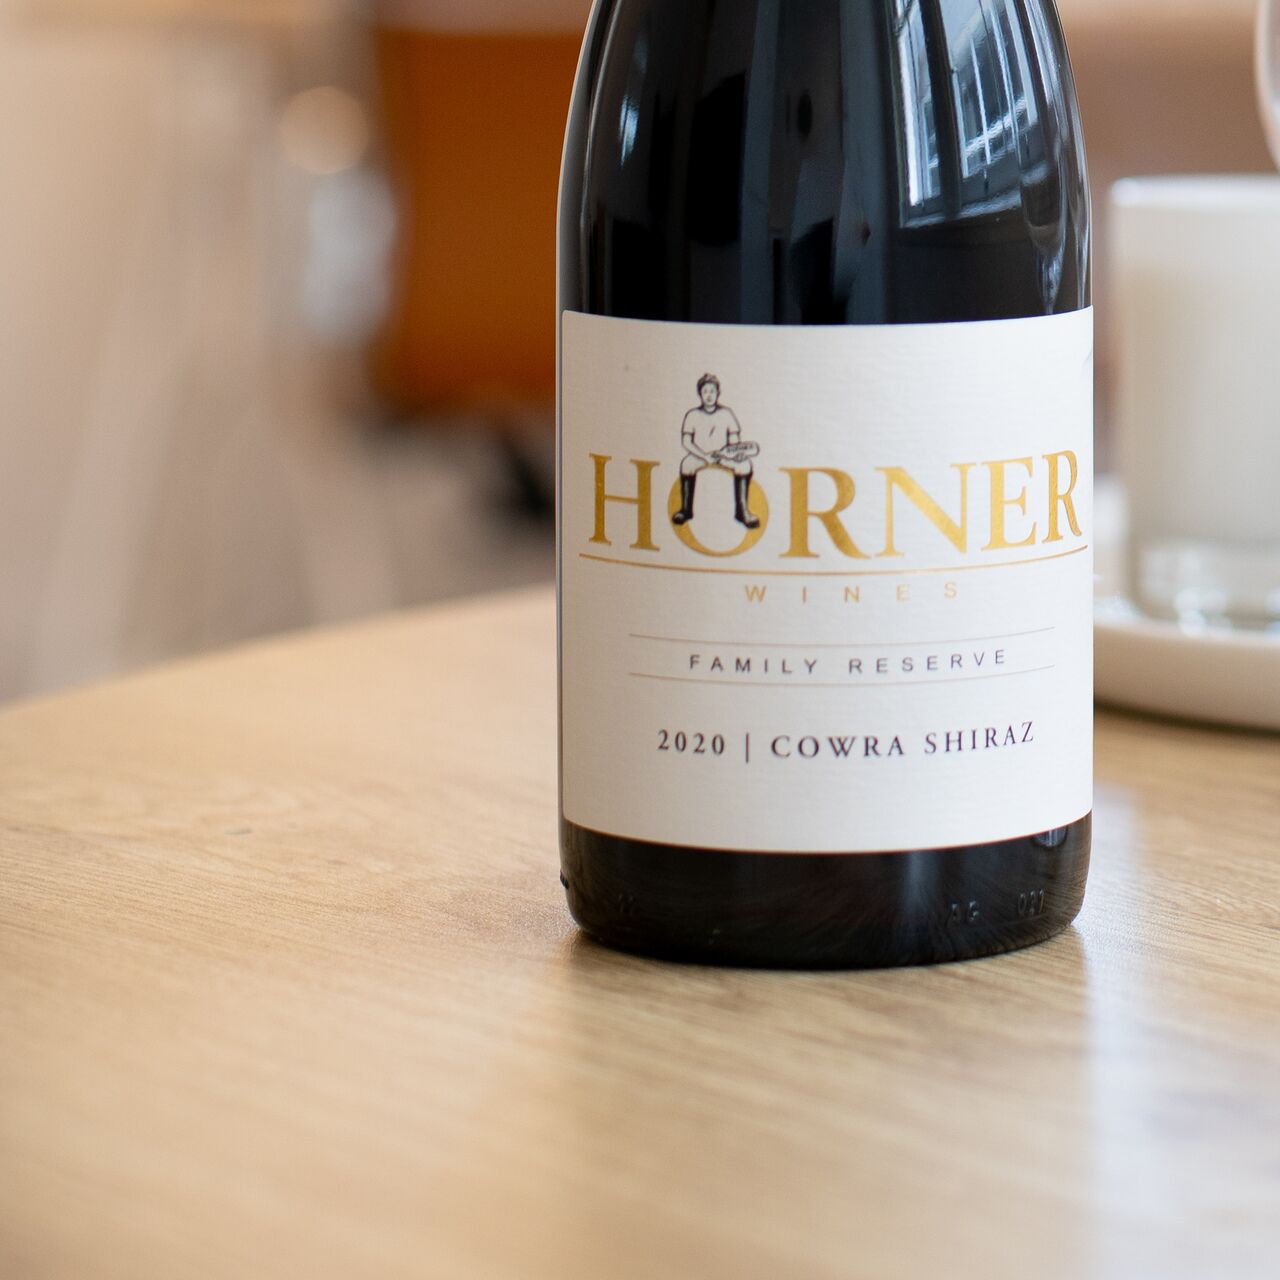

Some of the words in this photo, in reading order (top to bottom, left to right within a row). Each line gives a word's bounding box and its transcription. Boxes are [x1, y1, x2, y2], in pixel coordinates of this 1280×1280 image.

[588, 449, 1083, 560] HORNER
[744, 581, 958, 604] WINES
[689, 653, 818, 674] FAMILY
[848, 649, 1006, 674] RESERVE
[657, 728, 726, 755] 2020
[770, 734, 905, 759] COWRA
[923, 720, 1035, 755] SHIRAZ
